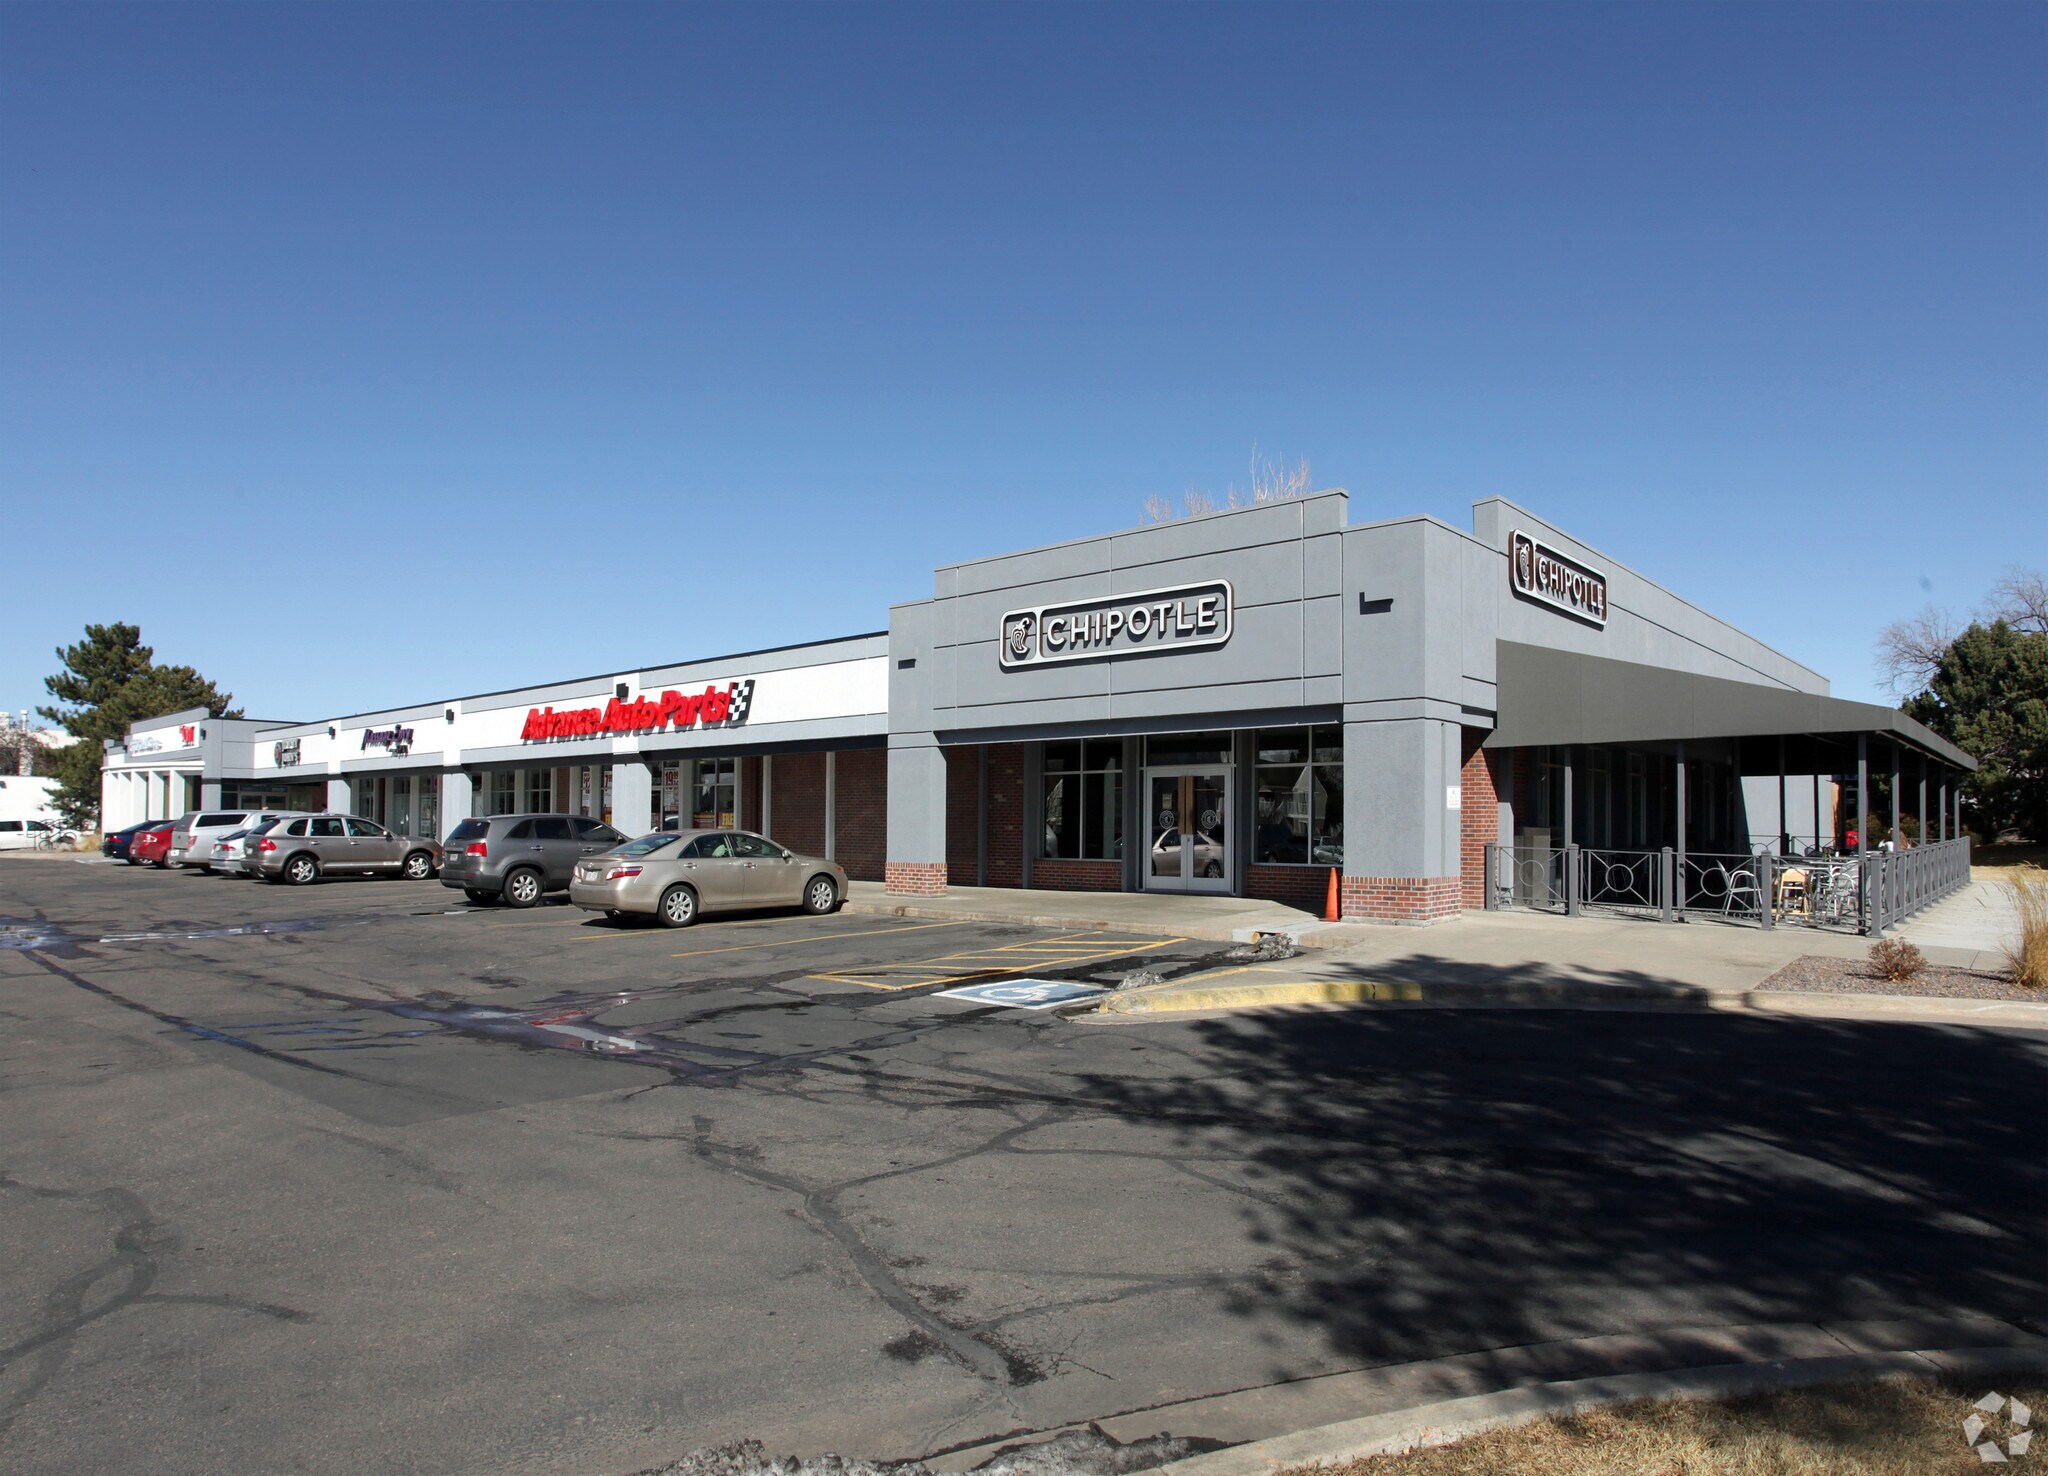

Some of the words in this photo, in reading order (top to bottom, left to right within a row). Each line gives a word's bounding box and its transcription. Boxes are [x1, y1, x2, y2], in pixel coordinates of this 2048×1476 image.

[1538, 556, 1604, 610] CHIPOTLE
[1047, 596, 1218, 646] CHIPOTLE
[520, 706, 602, 740] Advance
[598, 695, 660, 732] Auto
[656, 685, 728, 727] Parts
